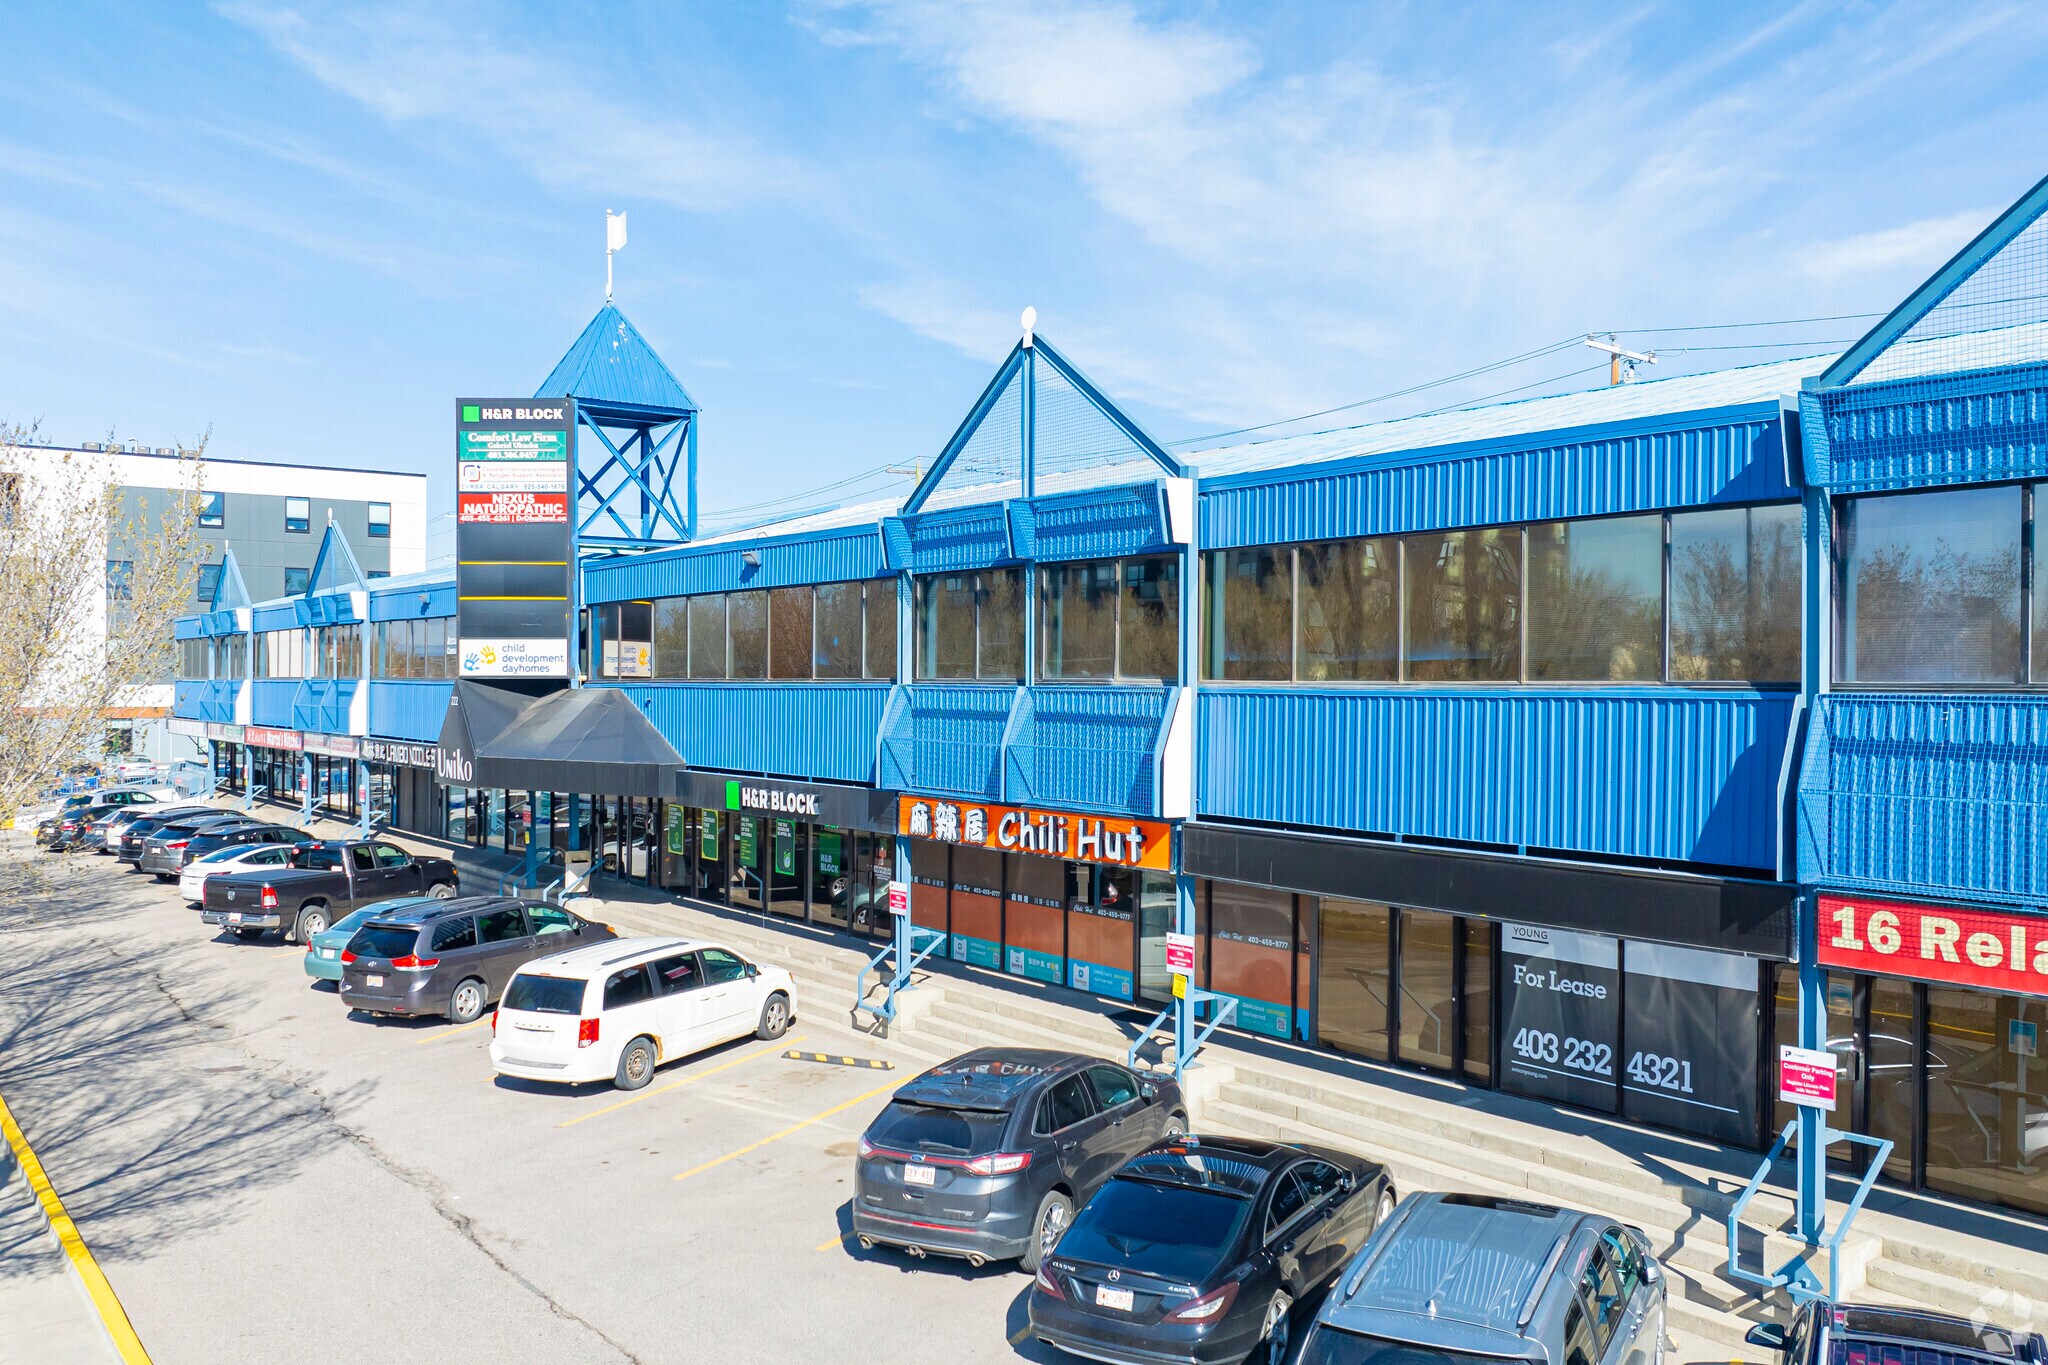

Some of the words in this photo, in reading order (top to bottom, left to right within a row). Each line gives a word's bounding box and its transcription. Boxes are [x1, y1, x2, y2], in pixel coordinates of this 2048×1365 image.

[482, 408, 513, 420] H&R
[515, 408, 564, 420] BLOCK
[468, 432, 510, 442] Comfort
[512, 432, 532, 442] Law
[533, 432, 557, 442] Firm
[492, 494, 536, 504] NEXUS
[463, 503, 564, 515] NATUROPATHIC
[501, 644, 526, 653] child
[501, 654, 565, 664] development
[501, 664, 551, 675] dayhomes
[741, 787, 769, 809] H&R
[771, 791, 819, 815] BLOCK
[909, 802, 988, 843] 麻辣居
[997, 811, 1069, 854] Chili
[1077, 818, 1147, 864] Hut
[820, 862, 839, 874] BLOCK
[1512, 926, 1549, 941] YOUNG
[1831, 906, 1902, 954] 16
[1513, 964, 1546, 989] For
[1548, 970, 1608, 1000] Lease
[1512, 1027, 1559, 1064] 403
[1563, 1037, 1613, 1076] 232
[1626, 1051, 1694, 1093] 4321
[1783, 1063, 1811, 1072] Customer
[1811, 1067, 1834, 1078] Parking
[1801, 1073, 1815, 1082] Only
